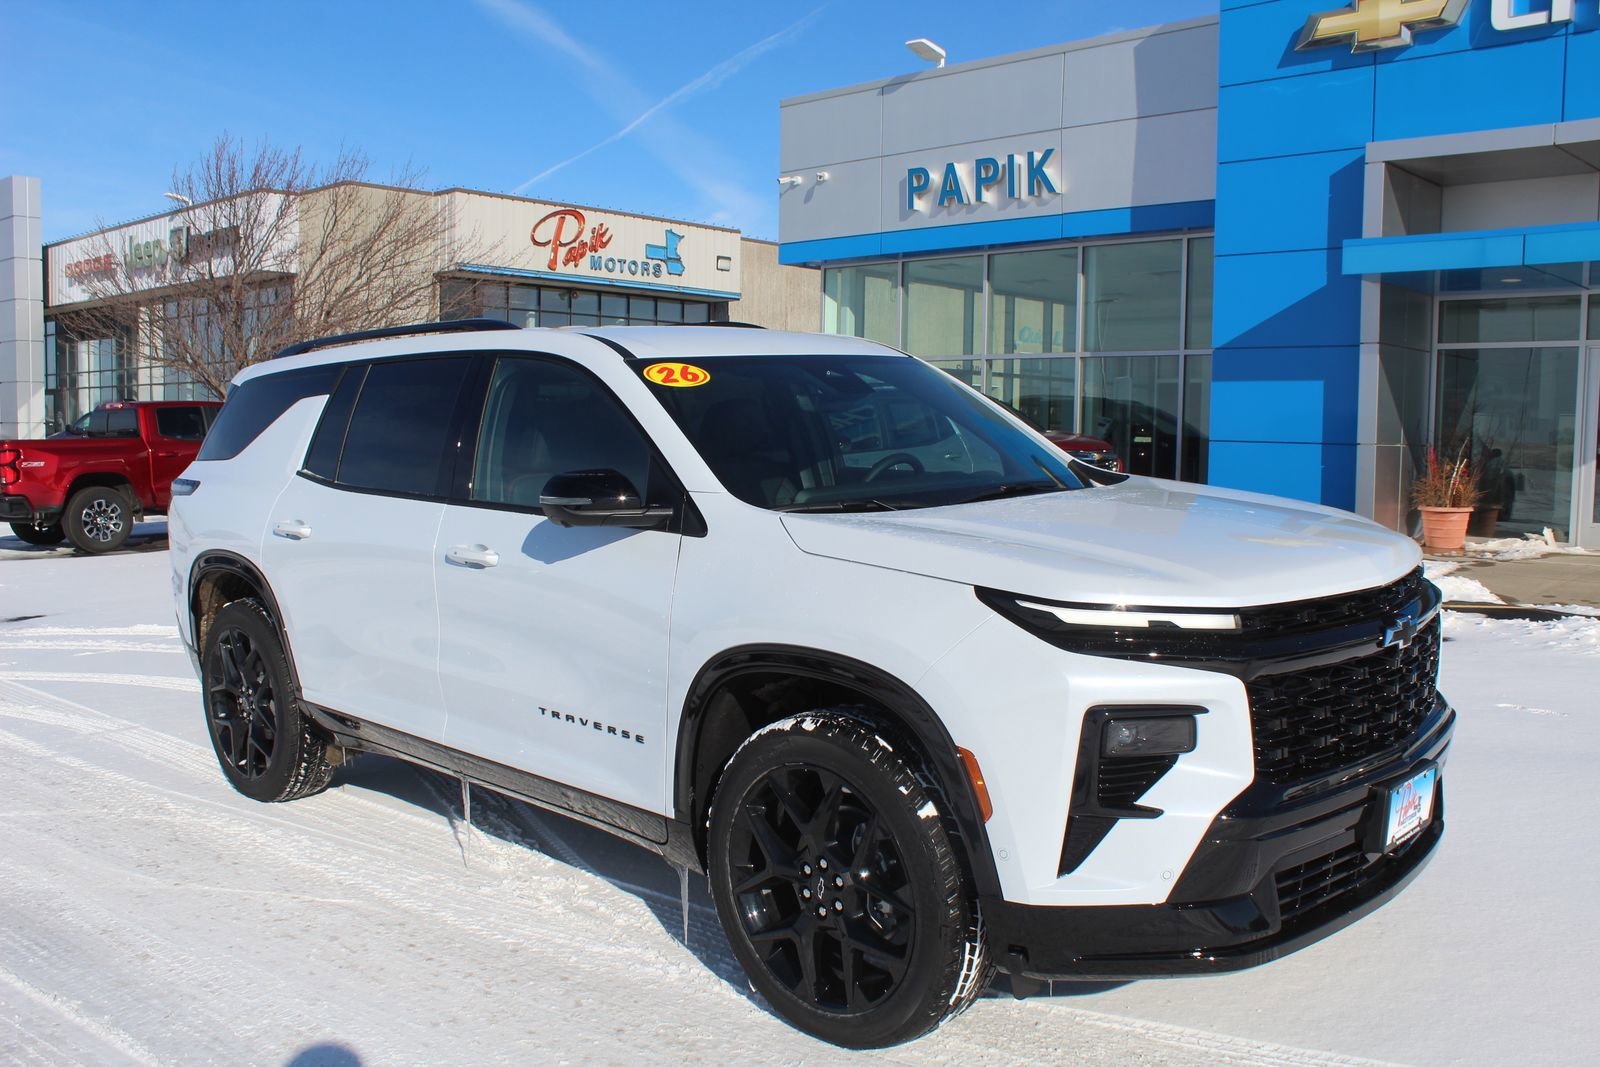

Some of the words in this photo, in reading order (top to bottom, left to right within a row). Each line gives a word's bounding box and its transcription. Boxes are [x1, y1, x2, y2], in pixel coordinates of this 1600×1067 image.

[907, 148, 1057, 211] PAPIK
[124, 235, 169, 269] Jeep
[530, 209, 613, 271] Papik
[589, 255, 662, 278] MOTORS
[657, 365, 700, 384] 26
[538, 706, 645, 744] TRAVERSE
